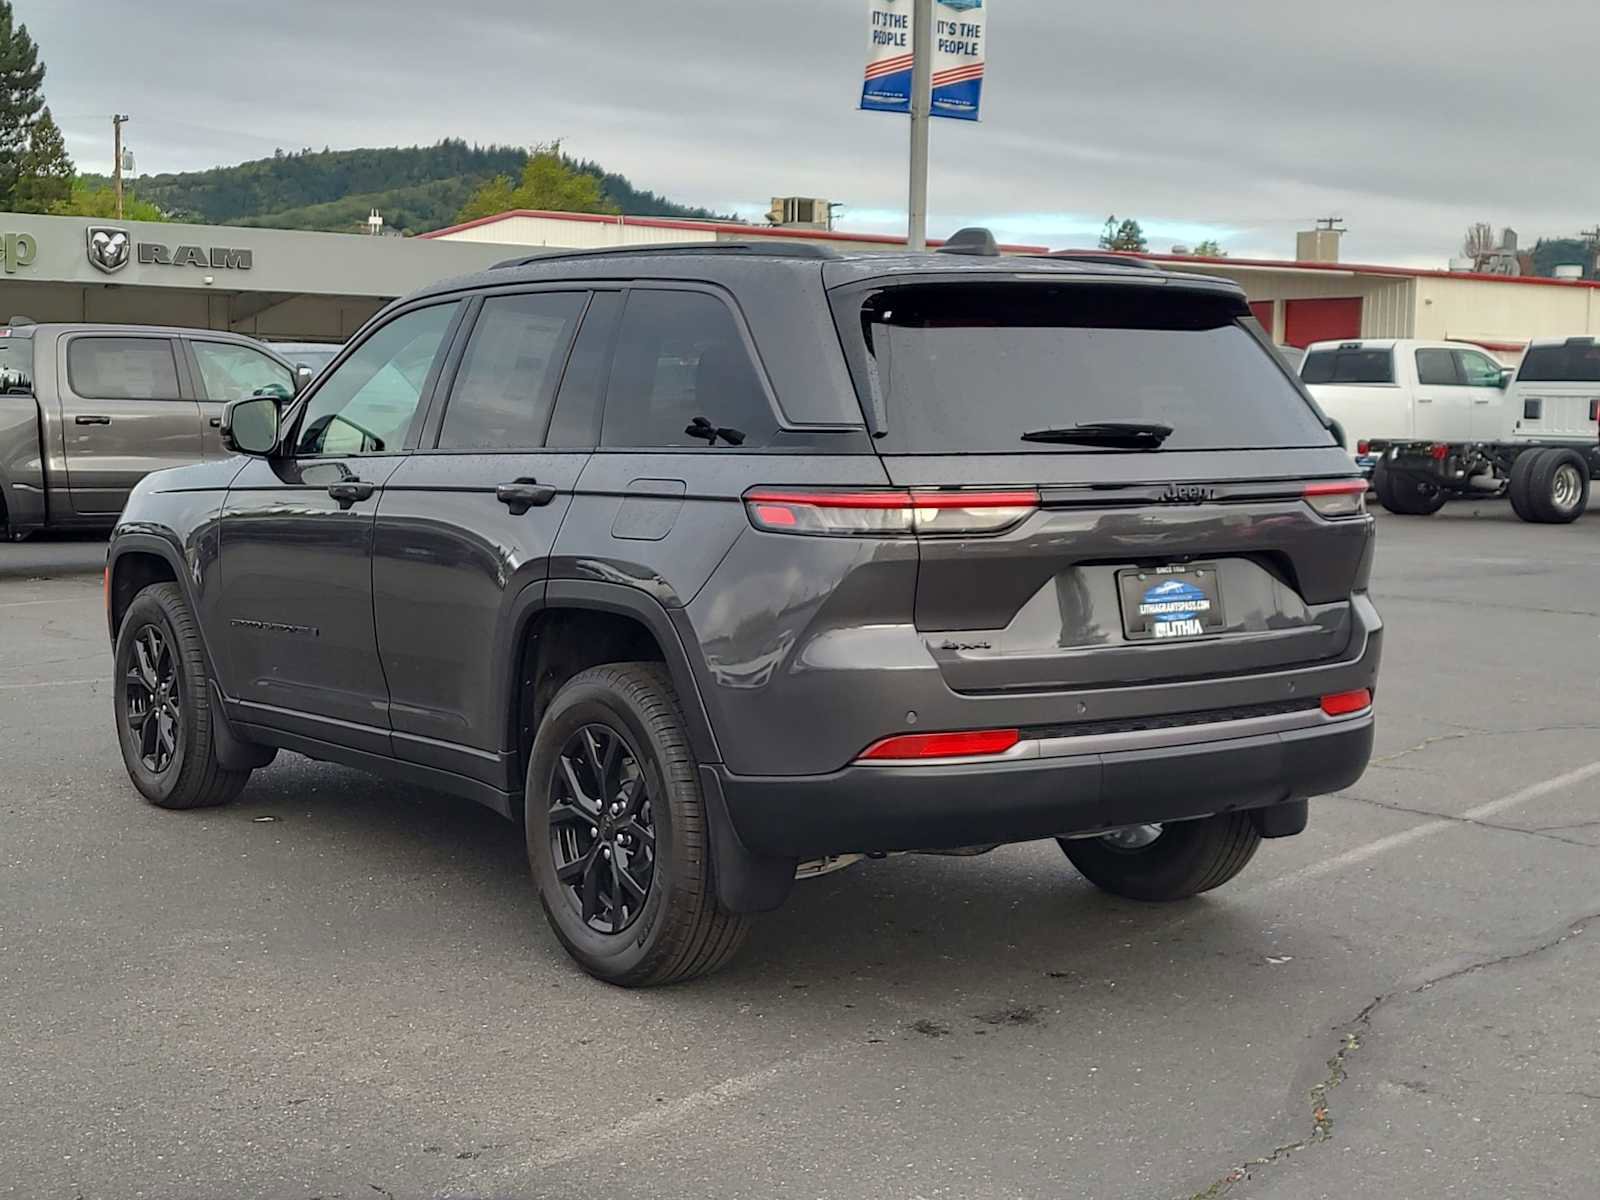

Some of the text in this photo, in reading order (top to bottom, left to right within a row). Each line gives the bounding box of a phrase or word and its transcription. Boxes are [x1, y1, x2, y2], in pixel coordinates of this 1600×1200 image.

[872, 11, 908, 29] IT'S THE
[873, 30, 907, 47] PEOPLE
[937, 20, 981, 39] IT'S THE
[938, 39, 978, 56] PEOPLE
[137, 242, 253, 270] RAM
[1167, 619, 1204, 637] LITHIA
